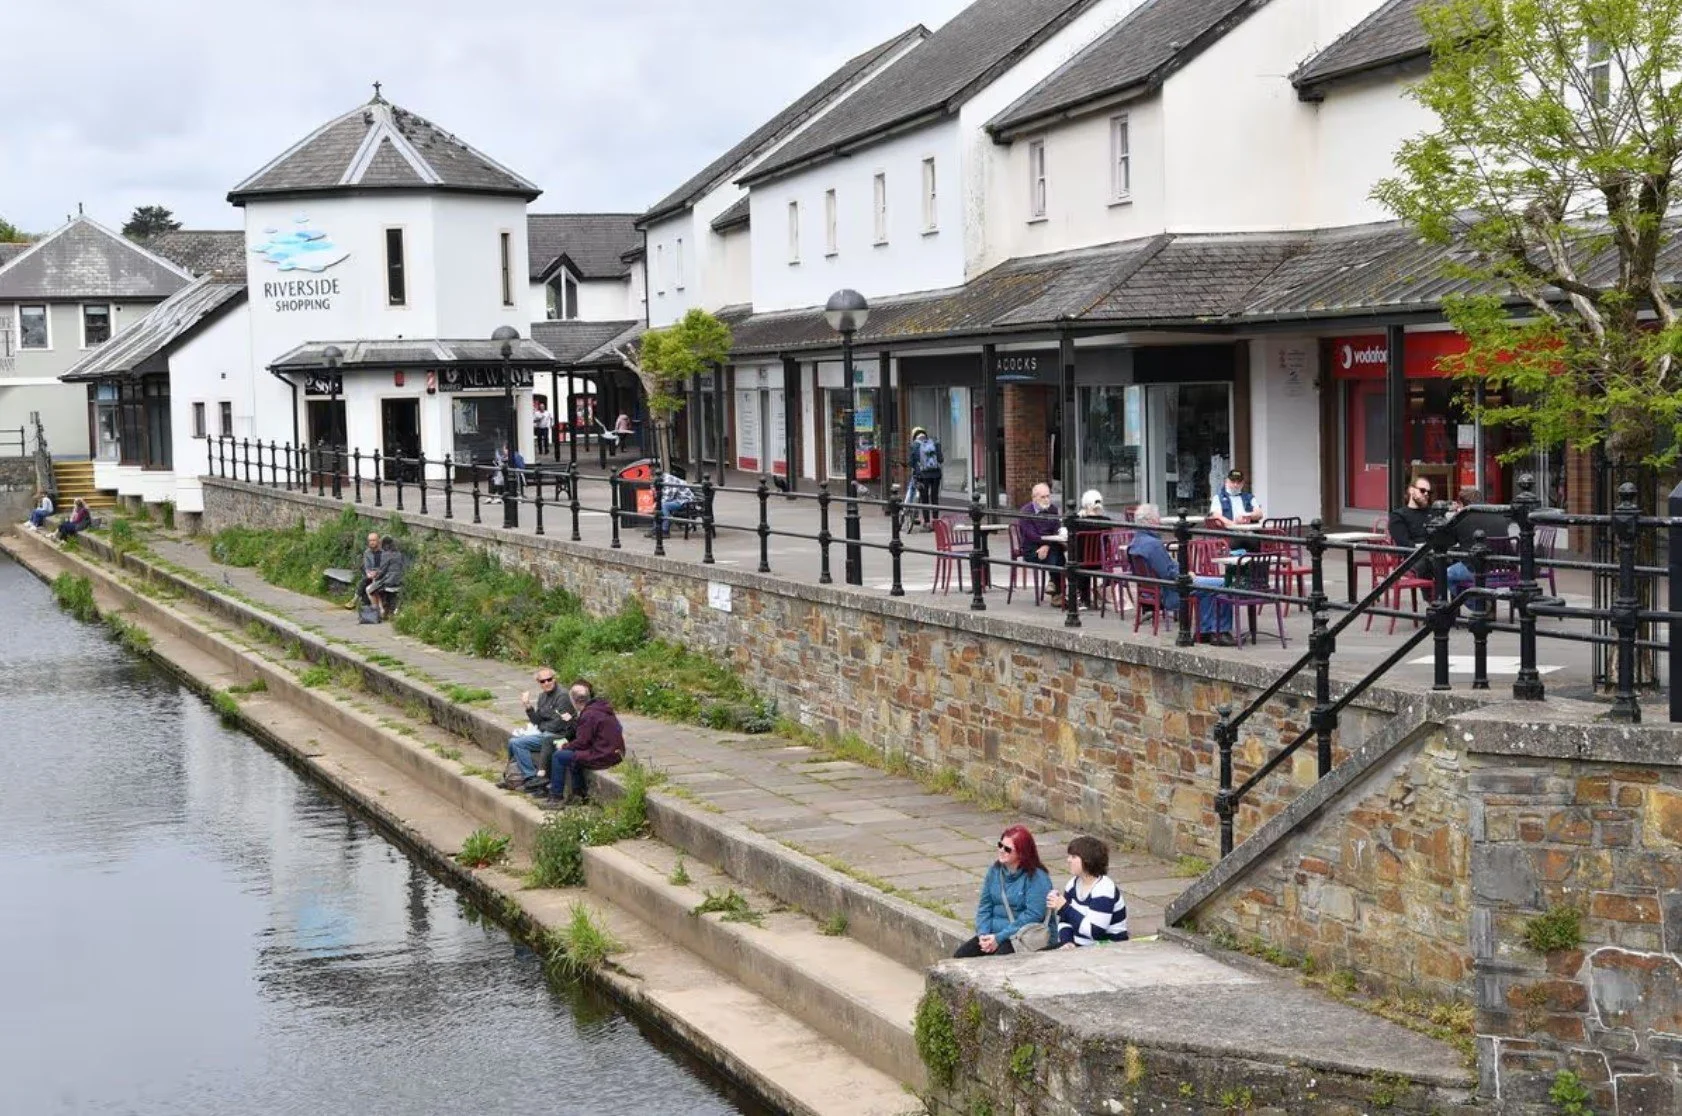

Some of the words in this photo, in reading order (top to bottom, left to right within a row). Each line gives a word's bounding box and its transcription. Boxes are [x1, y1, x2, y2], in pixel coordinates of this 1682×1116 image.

[264, 279, 341, 298] RIVERSIDE
[275, 298, 331, 312] SHOPPING
[1353, 345, 1388, 364] vodafo
[996, 356, 1037, 370] ACOCKS
